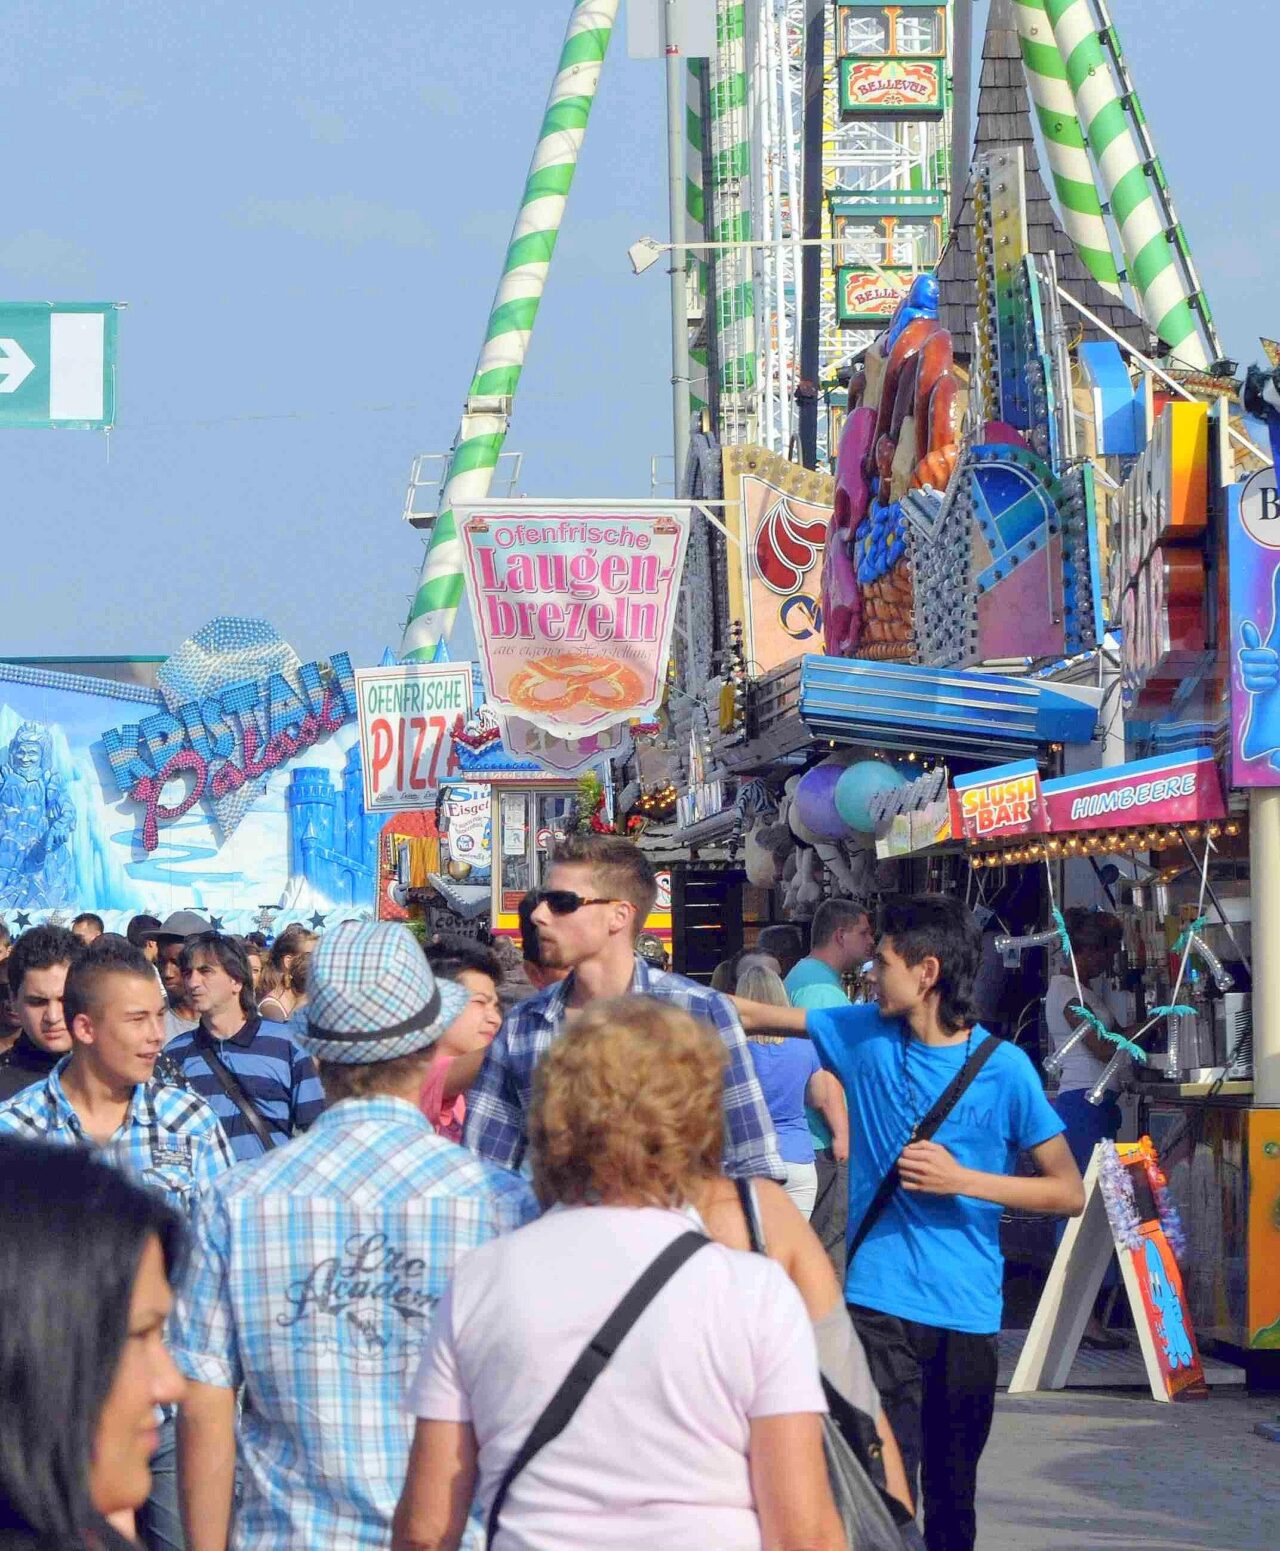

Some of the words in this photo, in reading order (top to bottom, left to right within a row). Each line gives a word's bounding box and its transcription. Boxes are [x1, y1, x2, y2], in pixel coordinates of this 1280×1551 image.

[857, 79, 927, 97] BELLEVUE
[494, 522, 651, 550] Ofenfrische
[476, 547, 675, 600] Laugen-
[486, 594, 659, 642] brezeln
[368, 680, 461, 713] OFENFRISCHE
[371, 713, 464, 793] PIZZA
[962, 775, 1037, 817] SLUSH
[976, 799, 1031, 835] BAR
[1071, 773, 1197, 821] HIMBEERE
